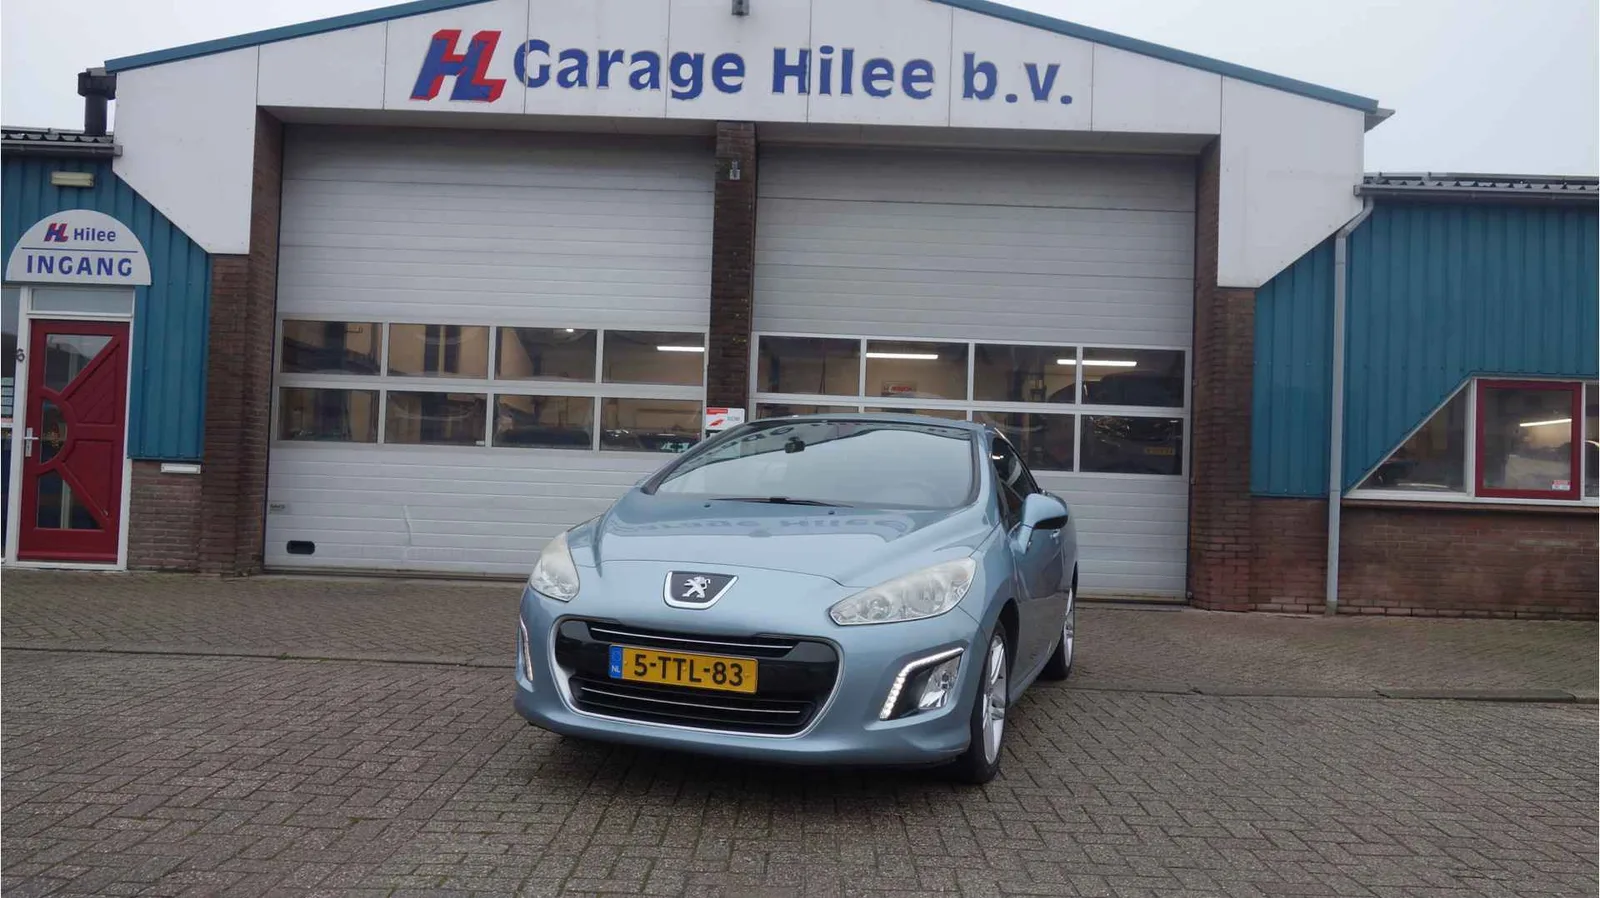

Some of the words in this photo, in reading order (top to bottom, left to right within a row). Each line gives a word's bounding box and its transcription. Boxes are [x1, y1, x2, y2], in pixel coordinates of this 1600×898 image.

[514, 39, 746, 101] Garage
[771, 46, 935, 99] Hilee
[964, 52, 1074, 104] b.v.
[73, 228, 116, 242] Hilee
[26, 255, 133, 276] INGANG
[611, 665, 621, 673] NL
[634, 654, 743, 686] 5-TTL-83
